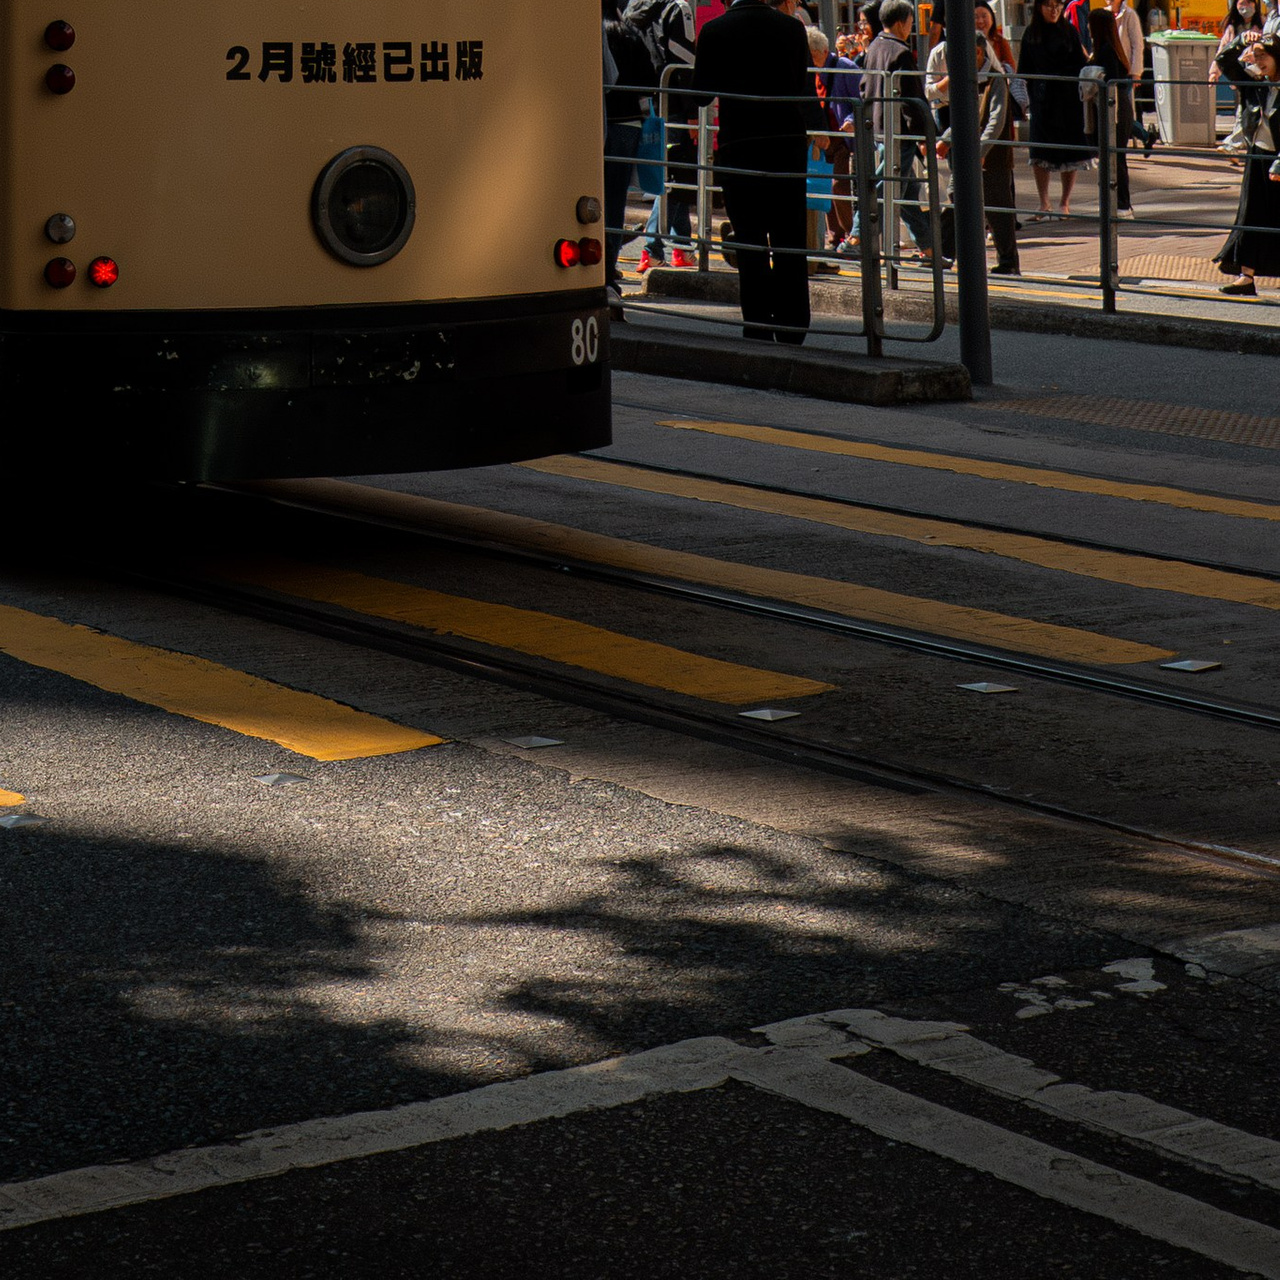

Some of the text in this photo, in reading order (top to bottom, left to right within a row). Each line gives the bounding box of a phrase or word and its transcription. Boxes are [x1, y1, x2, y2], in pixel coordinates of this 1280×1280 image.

[225, 40, 484, 83] 2月號經已出版
[570, 316, 599, 366] 80
